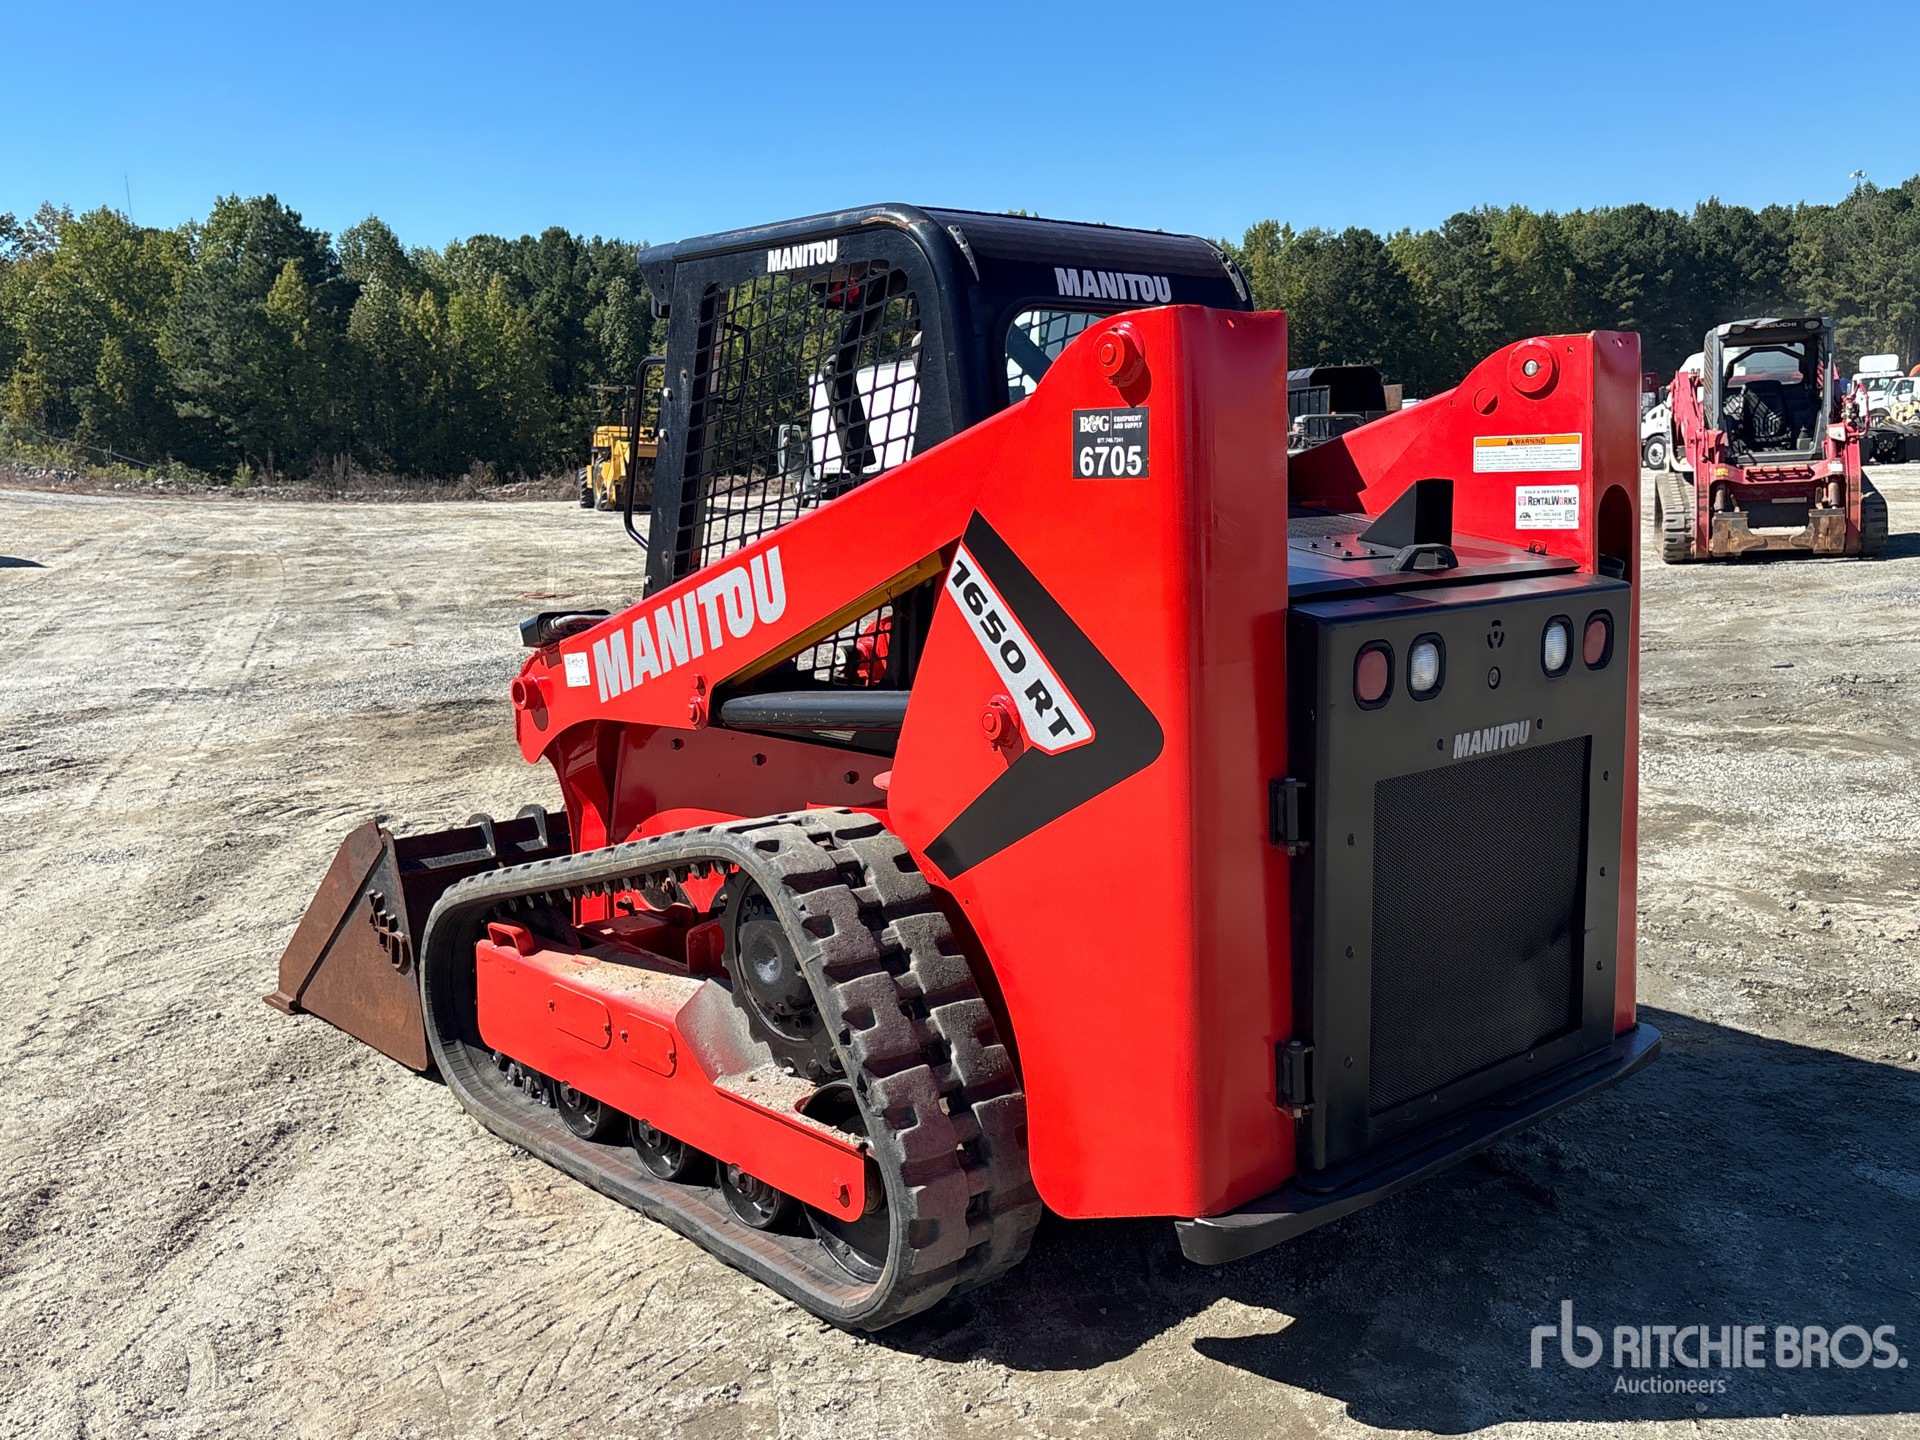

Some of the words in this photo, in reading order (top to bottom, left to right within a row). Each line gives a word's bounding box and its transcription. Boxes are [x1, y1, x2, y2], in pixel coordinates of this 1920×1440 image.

[767, 238, 838, 273] MANITOU
[1054, 267, 1172, 303] MANITOU
[1079, 415, 1110, 433] B&G
[1514, 437, 1546, 445] WARNING
[1079, 445, 1142, 476] 6705
[592, 545, 786, 703] MANITOU
[952, 560, 1027, 674] 1650
[1024, 678, 1076, 738] RT
[1453, 720, 1530, 760] MANITOU
